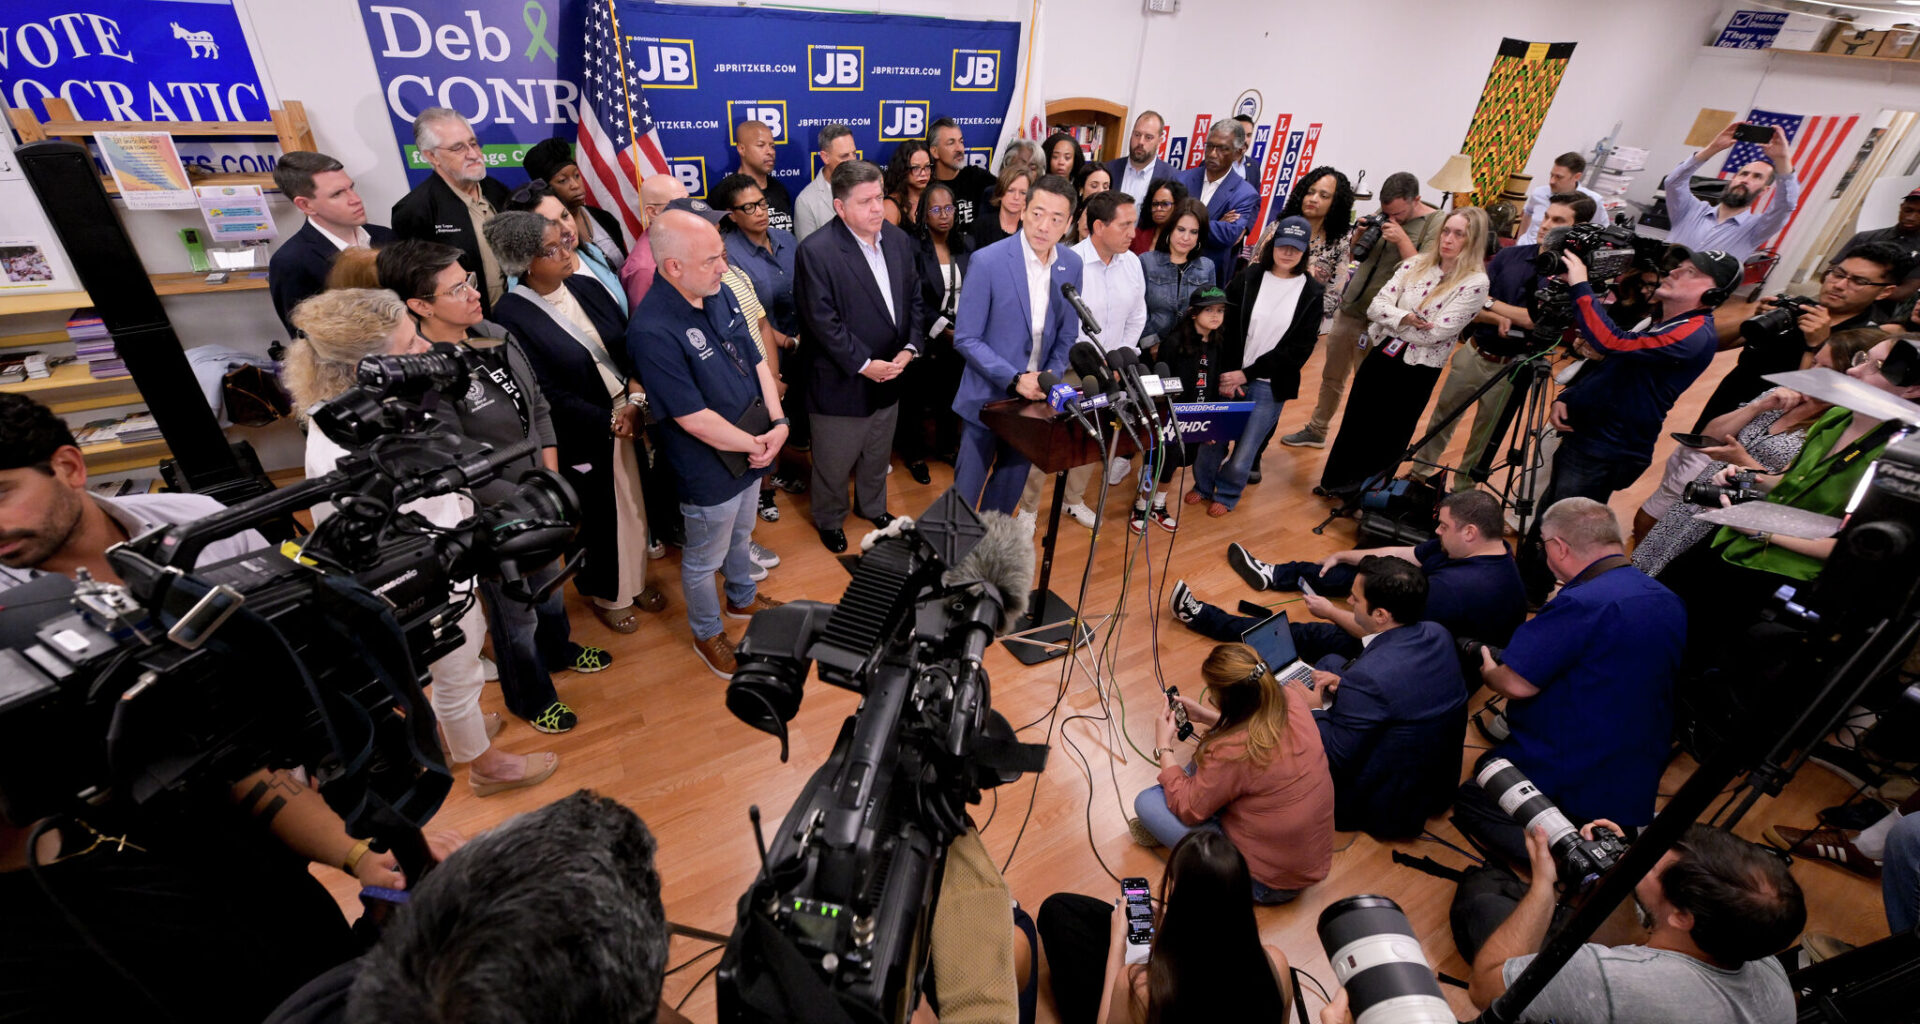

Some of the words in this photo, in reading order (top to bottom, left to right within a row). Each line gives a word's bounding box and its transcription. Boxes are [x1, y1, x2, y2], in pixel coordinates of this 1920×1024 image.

[0, 13, 134, 68] OTE
[370, 5, 511, 62] Deb
[1724, 30, 1754, 41] They
[637, 46, 690, 81] JB
[713, 63, 797, 73] JBPRITZKER.COM
[814, 53, 858, 84] JB
[871, 66, 941, 75] JBPRITZKER.COM
[955, 56, 995, 85] JB
[0, 79, 267, 122] OCRATIC
[654, 121, 718, 129] ITZKER.COM
[883, 107, 924, 136] JB
[1260, 118, 1288, 197] LISLE
[1275, 134, 1302, 197] YORK
[1296, 127, 1321, 182] WAY
[668, 164, 700, 193] B
[1173, 404, 1229, 412] HOUSEDEMS.com
[1179, 420, 1211, 433] HDC
